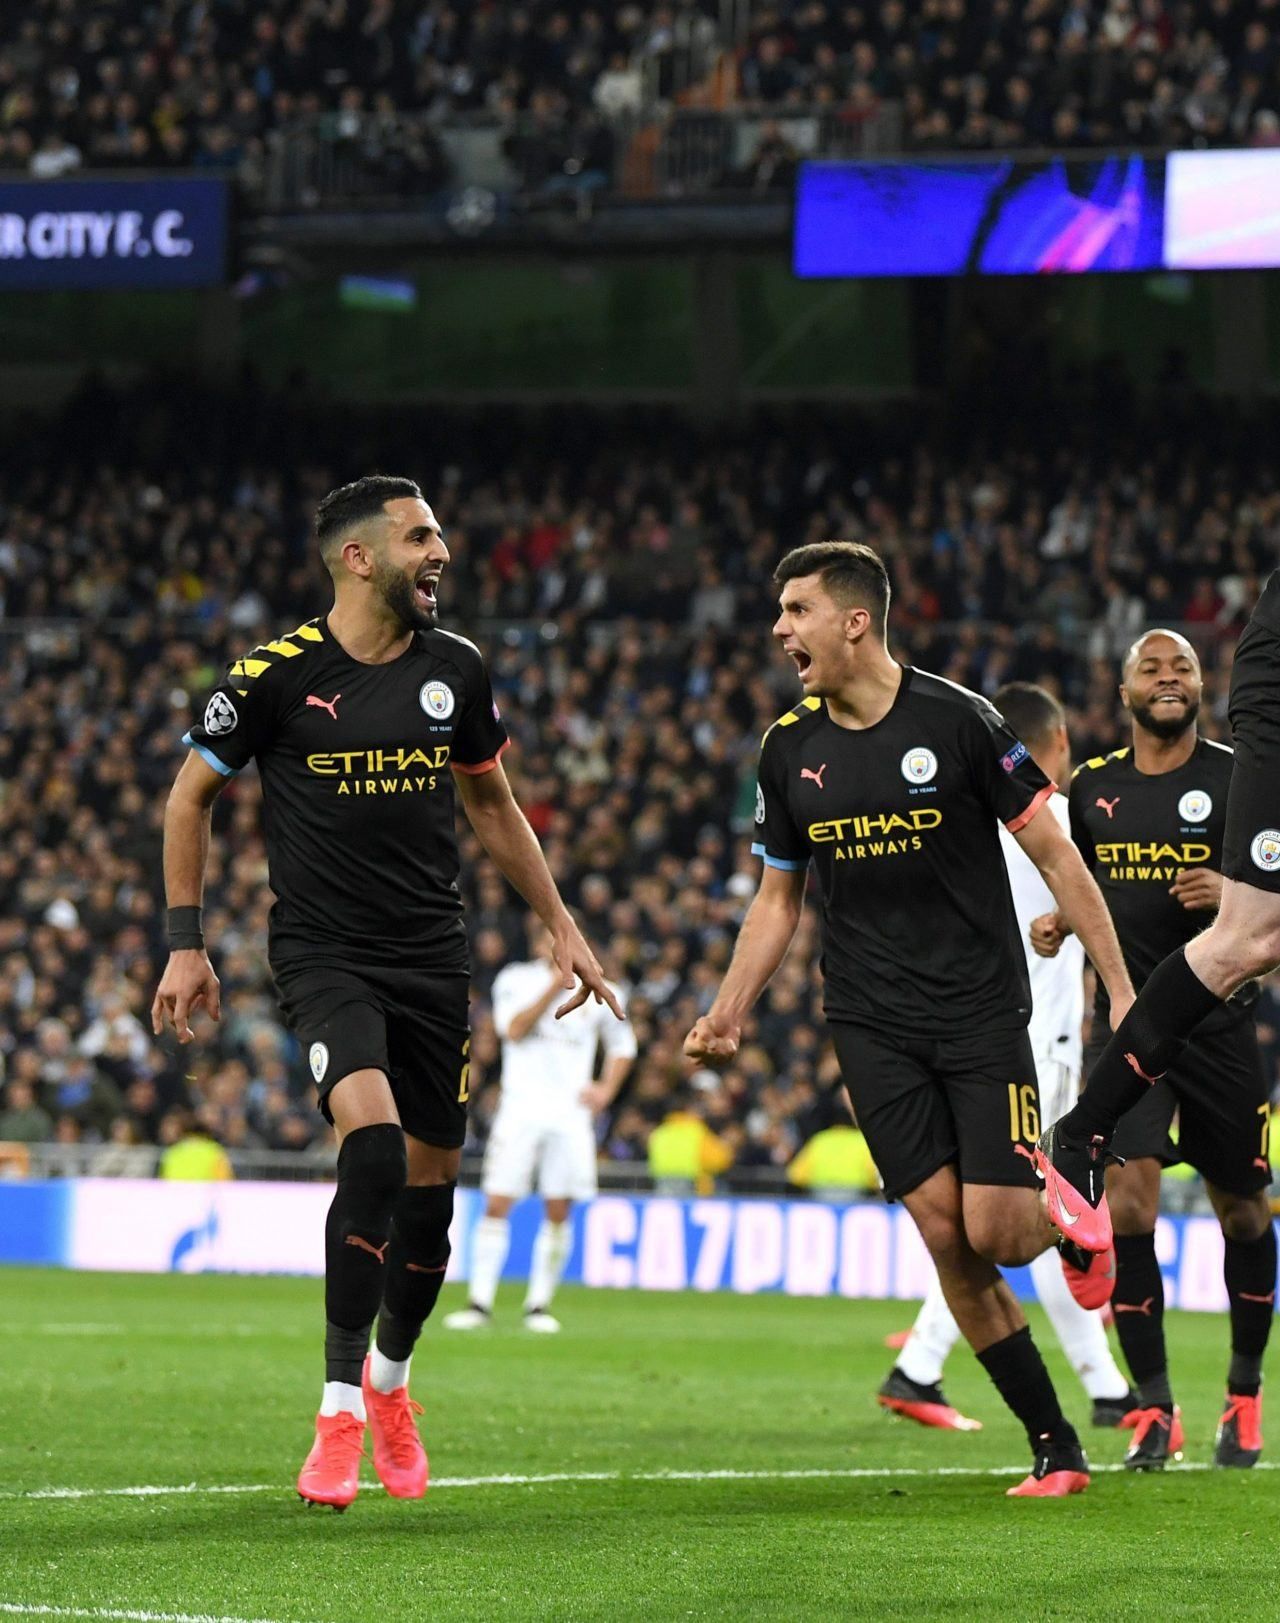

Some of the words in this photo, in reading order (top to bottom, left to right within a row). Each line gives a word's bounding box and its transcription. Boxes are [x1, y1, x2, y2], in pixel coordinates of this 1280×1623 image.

[28, 211, 113, 259] CITY
[306, 746, 450, 775] ETIHAD
[337, 775, 437, 796] AIRWAYS
[807, 808, 943, 843] ETIHAD
[834, 836, 922, 860] AIRWAYS
[1095, 842, 1211, 863] ETIHAD
[1008, 1082, 1040, 1144] 16
